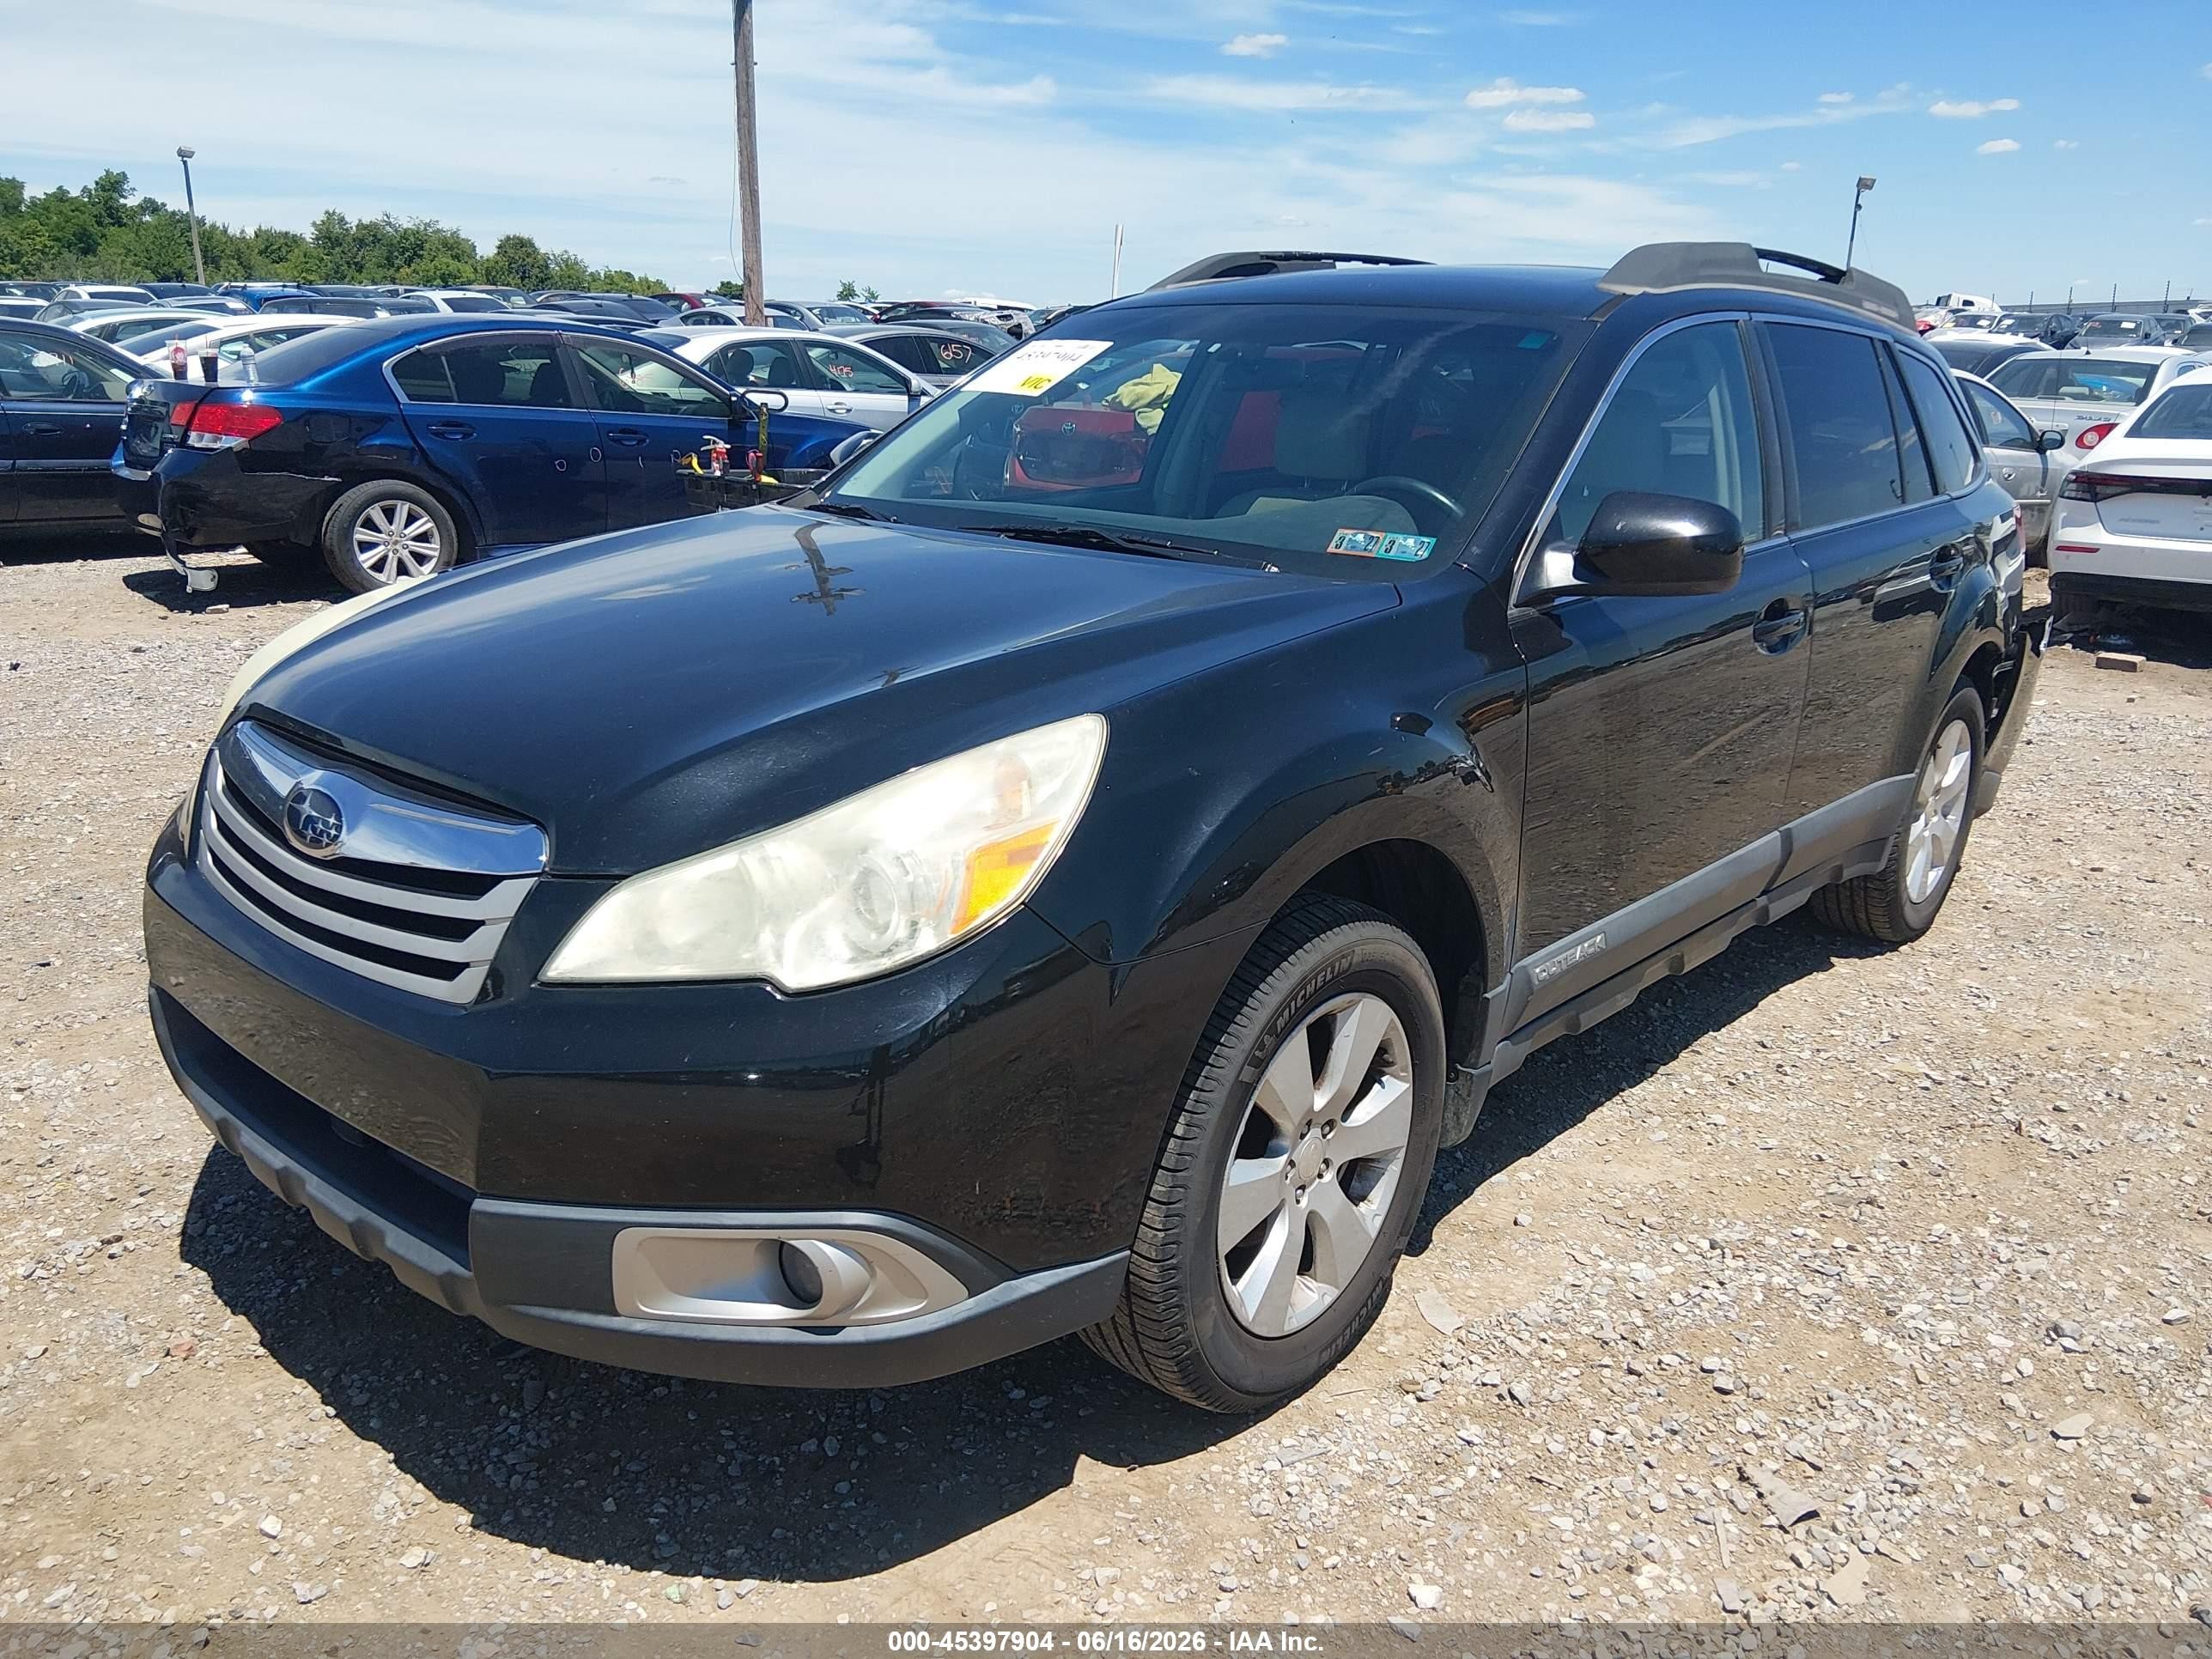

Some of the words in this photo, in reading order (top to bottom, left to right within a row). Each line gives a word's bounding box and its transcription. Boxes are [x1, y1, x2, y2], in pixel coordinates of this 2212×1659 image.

[940, 343, 974, 364] 657
[1334, 535, 1346, 550] 3
[1364, 535, 1381, 553] 27
[1384, 539, 1396, 554] 3
[1414, 540, 1431, 557] 27
[1276, 954, 1354, 1034] MICHELIN
